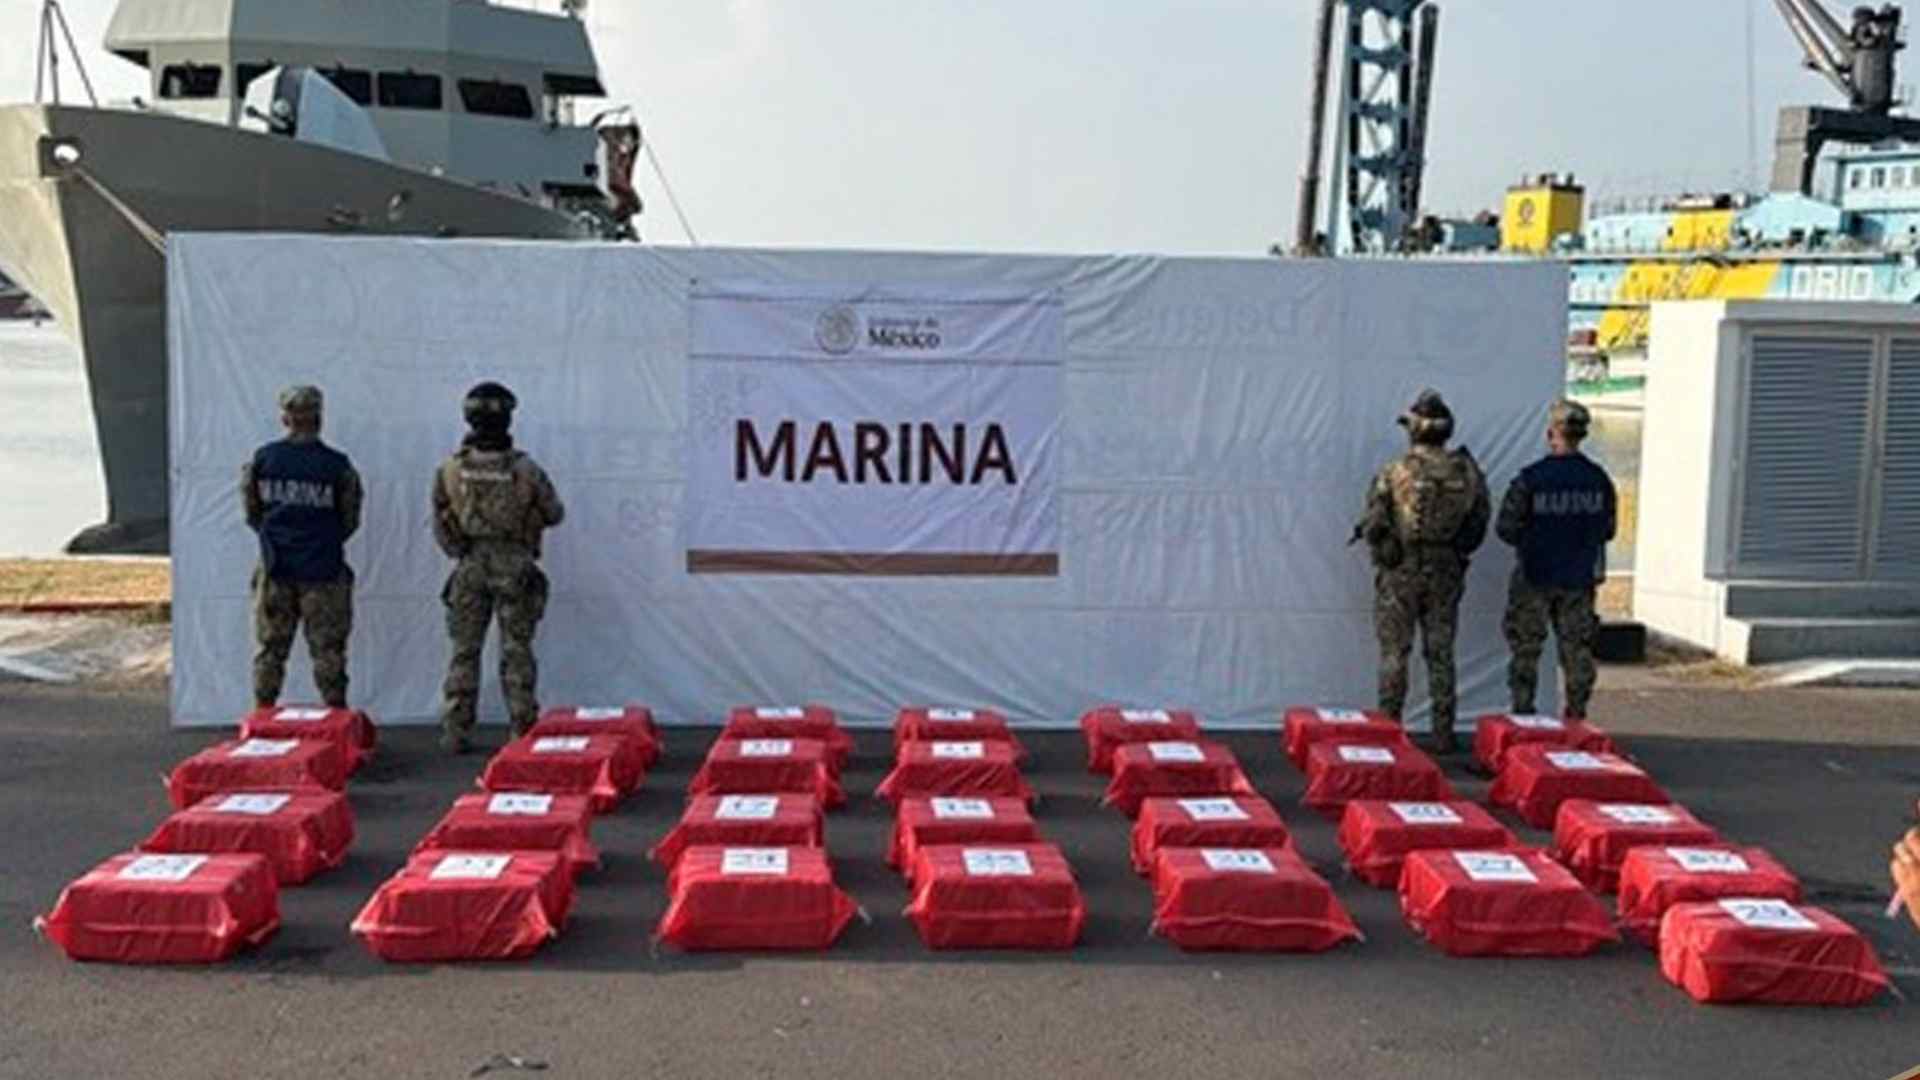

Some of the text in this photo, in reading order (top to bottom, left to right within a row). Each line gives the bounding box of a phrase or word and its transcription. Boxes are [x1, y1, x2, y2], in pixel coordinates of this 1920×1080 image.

[867, 326, 941, 350] México
[735, 418, 1018, 486] MARINA
[257, 479, 334, 508] MARINA
